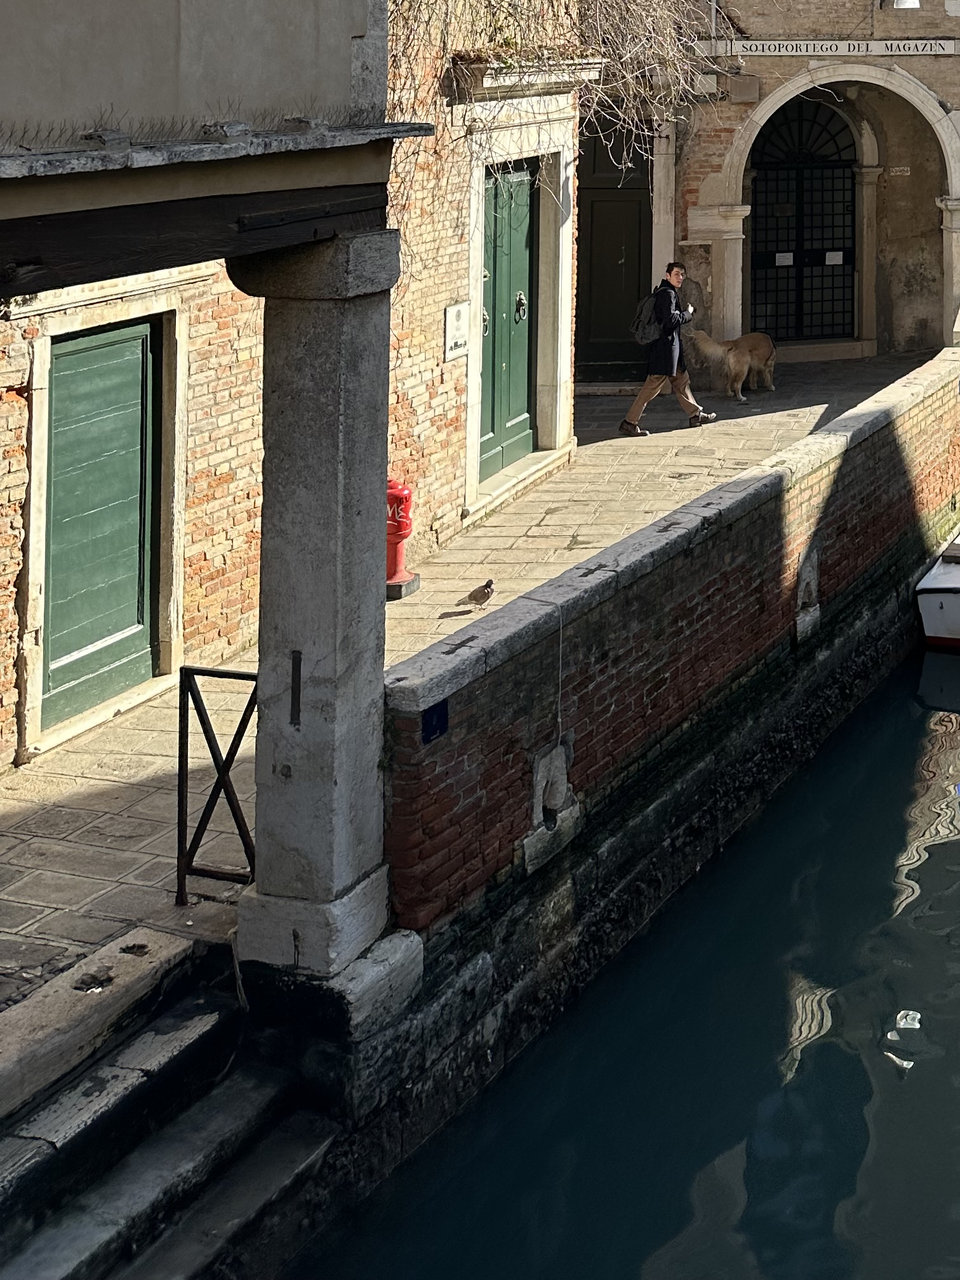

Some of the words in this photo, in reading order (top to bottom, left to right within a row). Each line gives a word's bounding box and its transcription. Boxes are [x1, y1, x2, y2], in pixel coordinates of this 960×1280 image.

[741, 42, 839, 53] SOTOPORTEGO
[847, 42, 873, 53] DEL
[885, 42, 946, 53] MAGAZEN
